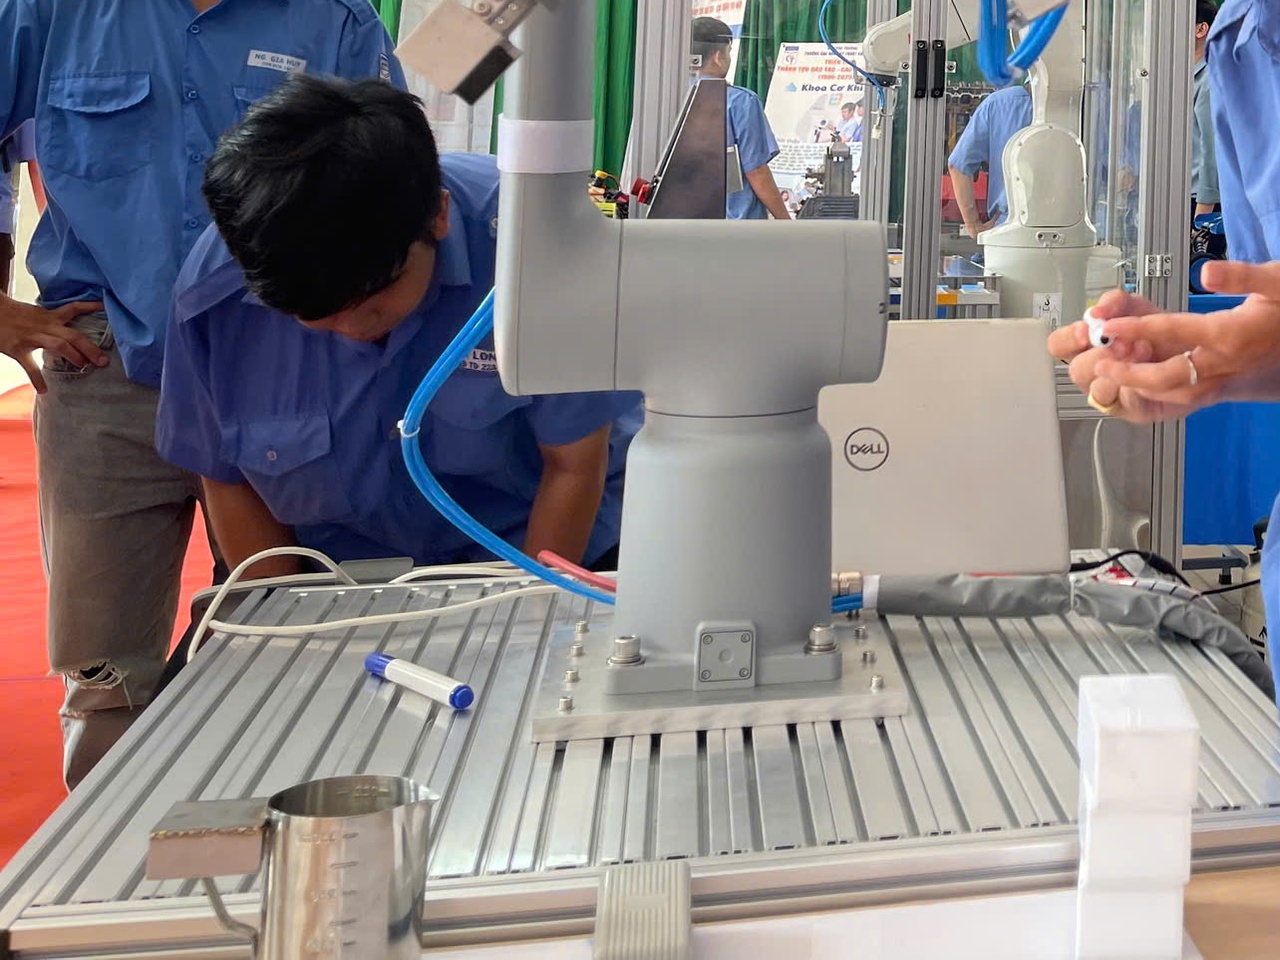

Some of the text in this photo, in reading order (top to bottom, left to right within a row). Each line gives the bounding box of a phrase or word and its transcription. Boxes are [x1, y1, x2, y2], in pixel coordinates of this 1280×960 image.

[801, 84, 828, 92] Khoa
[829, 84, 846, 92] Cơ
[850, 443, 885, 455] DELL
